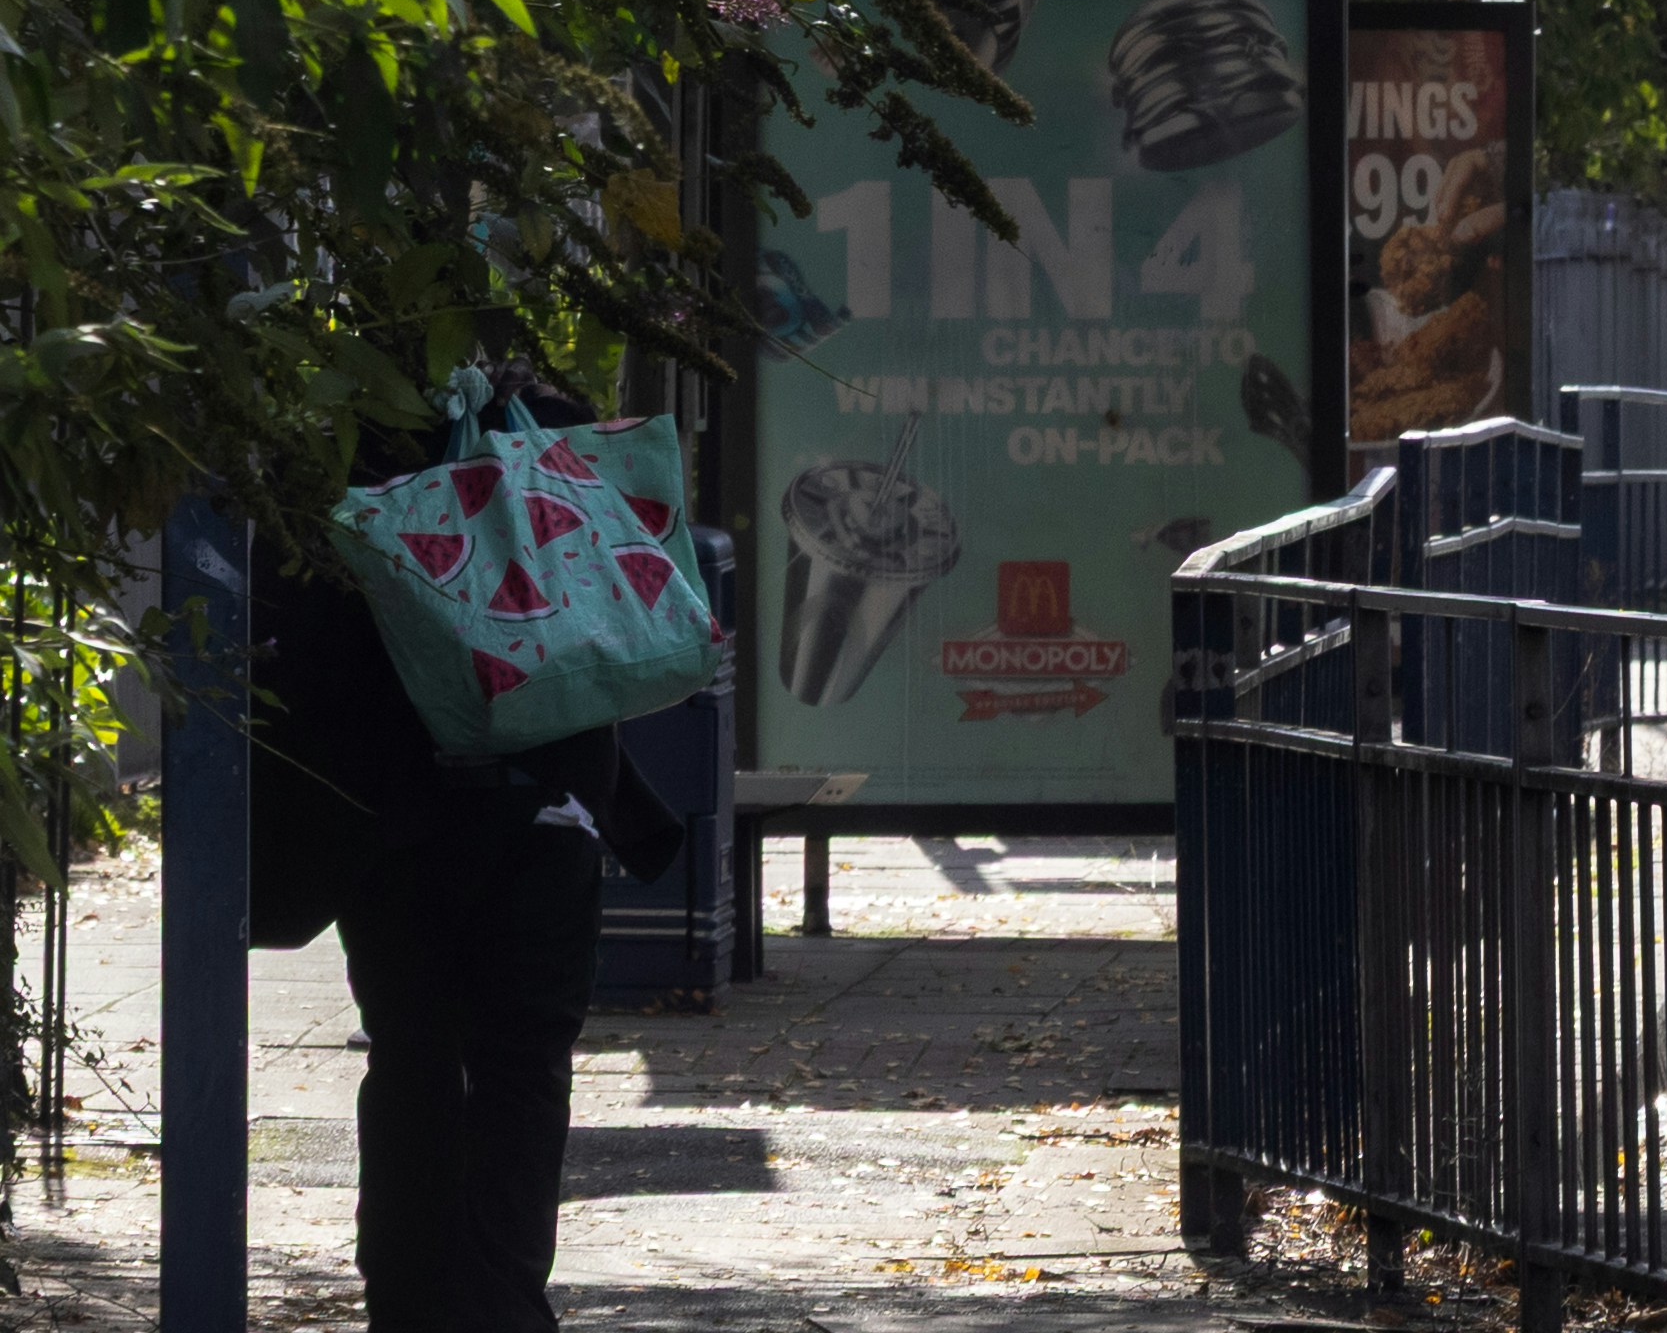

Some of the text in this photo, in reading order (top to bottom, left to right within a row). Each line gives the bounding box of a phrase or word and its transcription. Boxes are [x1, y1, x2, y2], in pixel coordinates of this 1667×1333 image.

[816, 177, 1256, 319] 1 IN 4
[983, 327, 1256, 367] CHANCE TO
[833, 374, 1194, 415] WIN INSTANTLY
[1006, 426, 1226, 465] ON-PACK
[946, 646, 1122, 672] MONOPOLY
